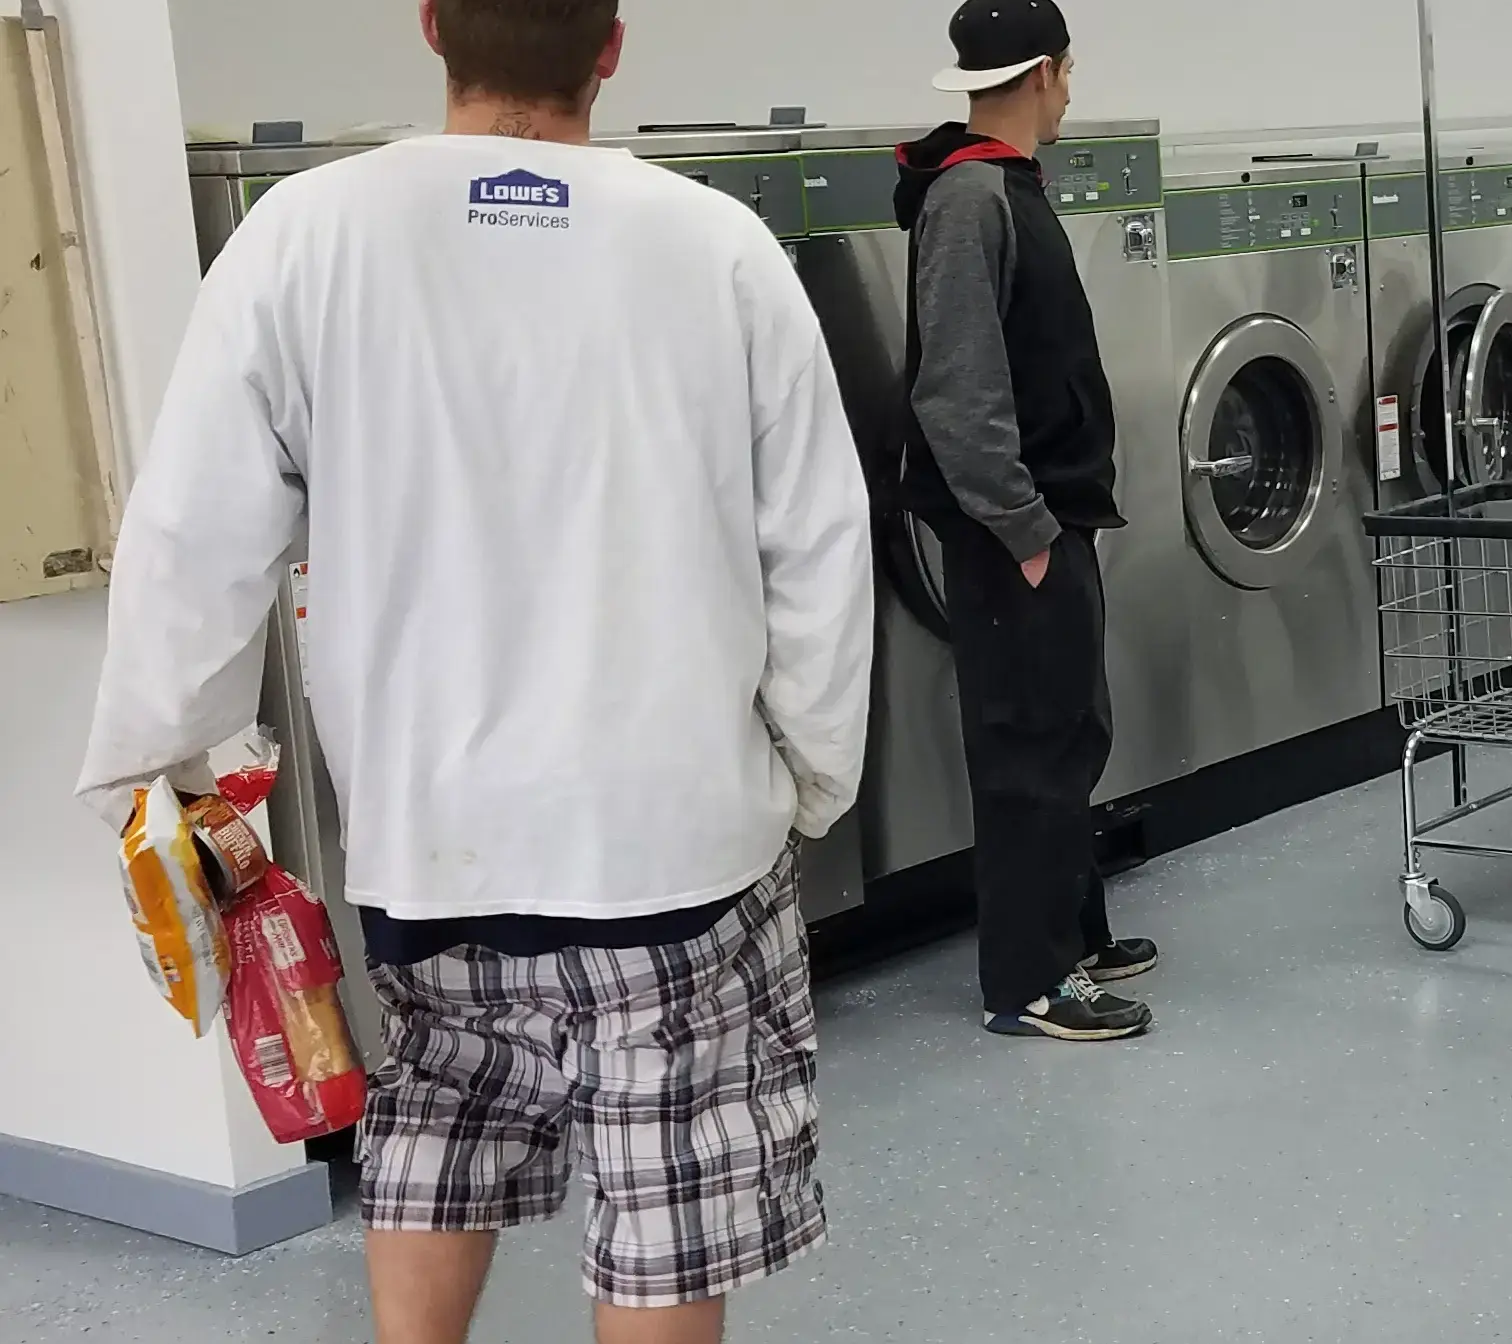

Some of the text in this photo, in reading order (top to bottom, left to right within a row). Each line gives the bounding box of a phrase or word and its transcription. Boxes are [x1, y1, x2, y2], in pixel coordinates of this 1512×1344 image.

[480, 181, 560, 204] LOWE'S
[467, 208, 570, 229] ProServices
[218, 825, 250, 869] BUFFALO
